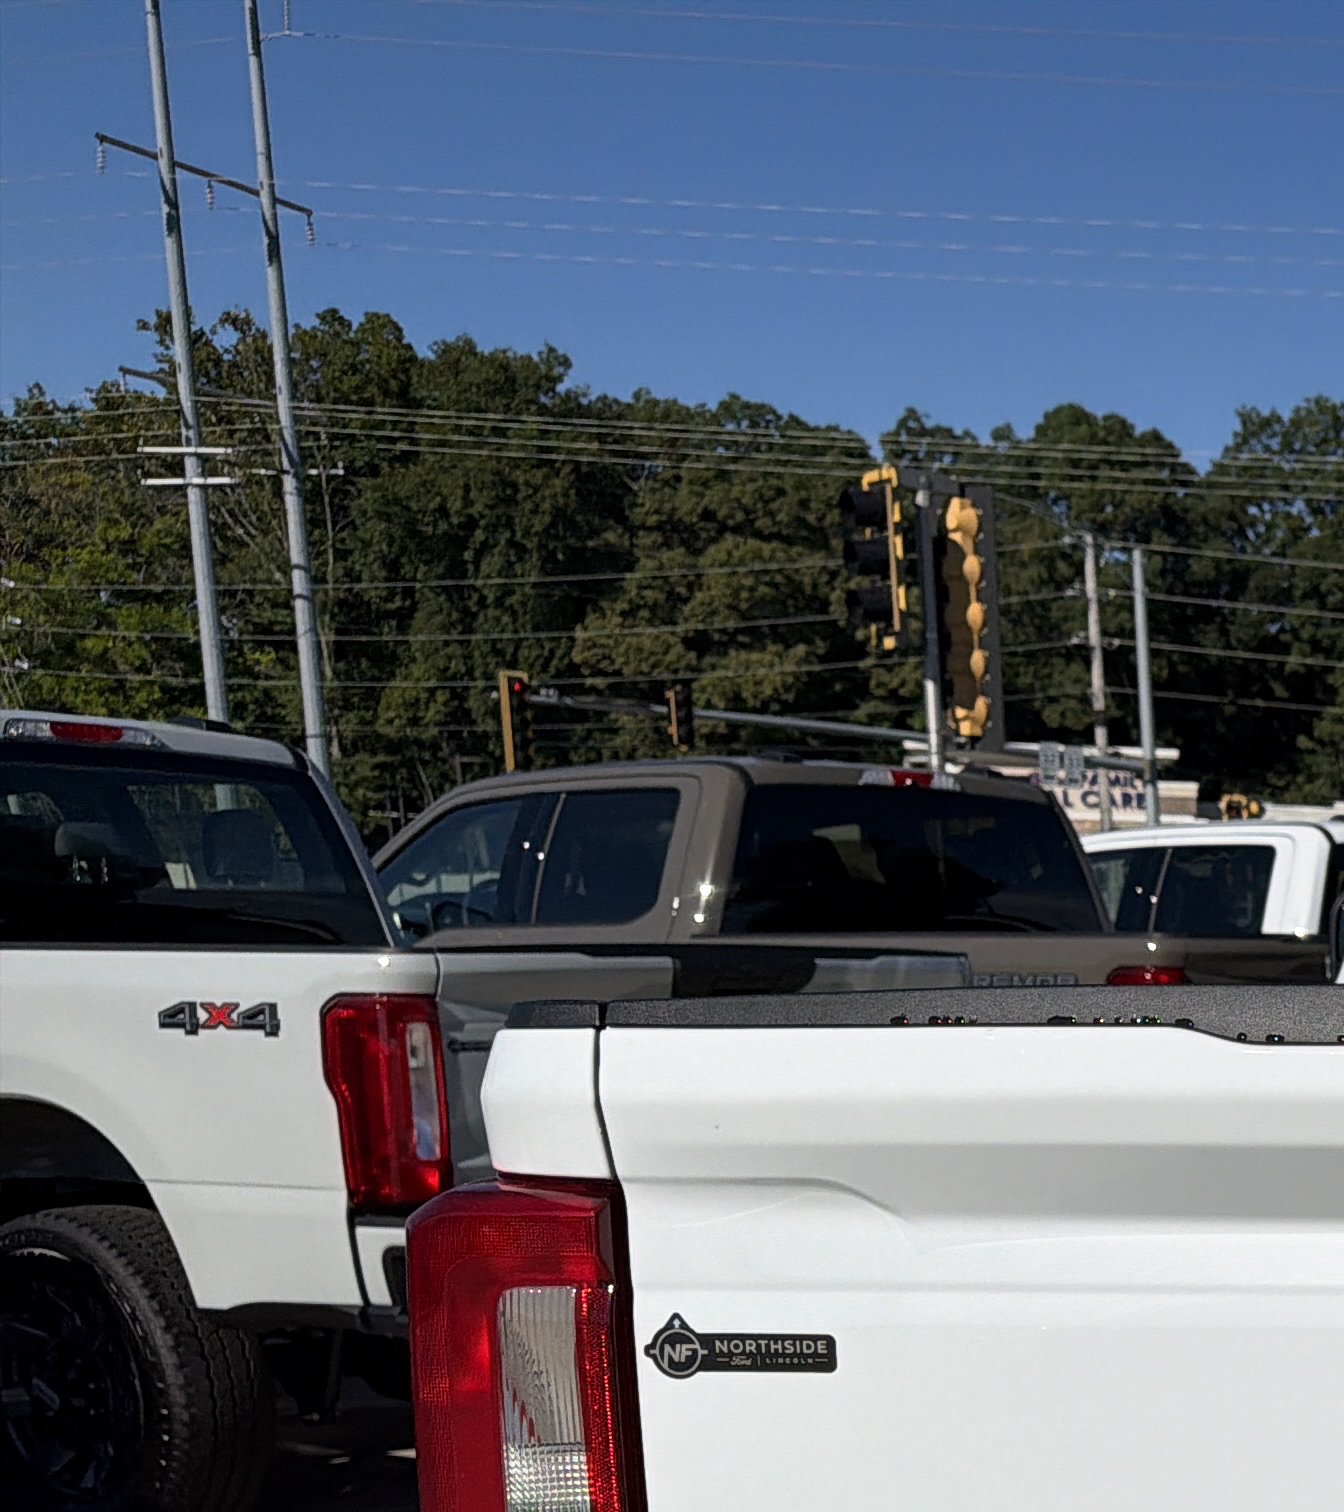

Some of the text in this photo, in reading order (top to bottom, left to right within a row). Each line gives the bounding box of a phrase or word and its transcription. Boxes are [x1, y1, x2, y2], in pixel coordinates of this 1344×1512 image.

[973, 974, 1079, 987] REMOR
[714, 1340, 828, 1354] NORTHSIDE
[663, 1344, 699, 1368] NF
[730, 1356, 753, 1366] Ford
